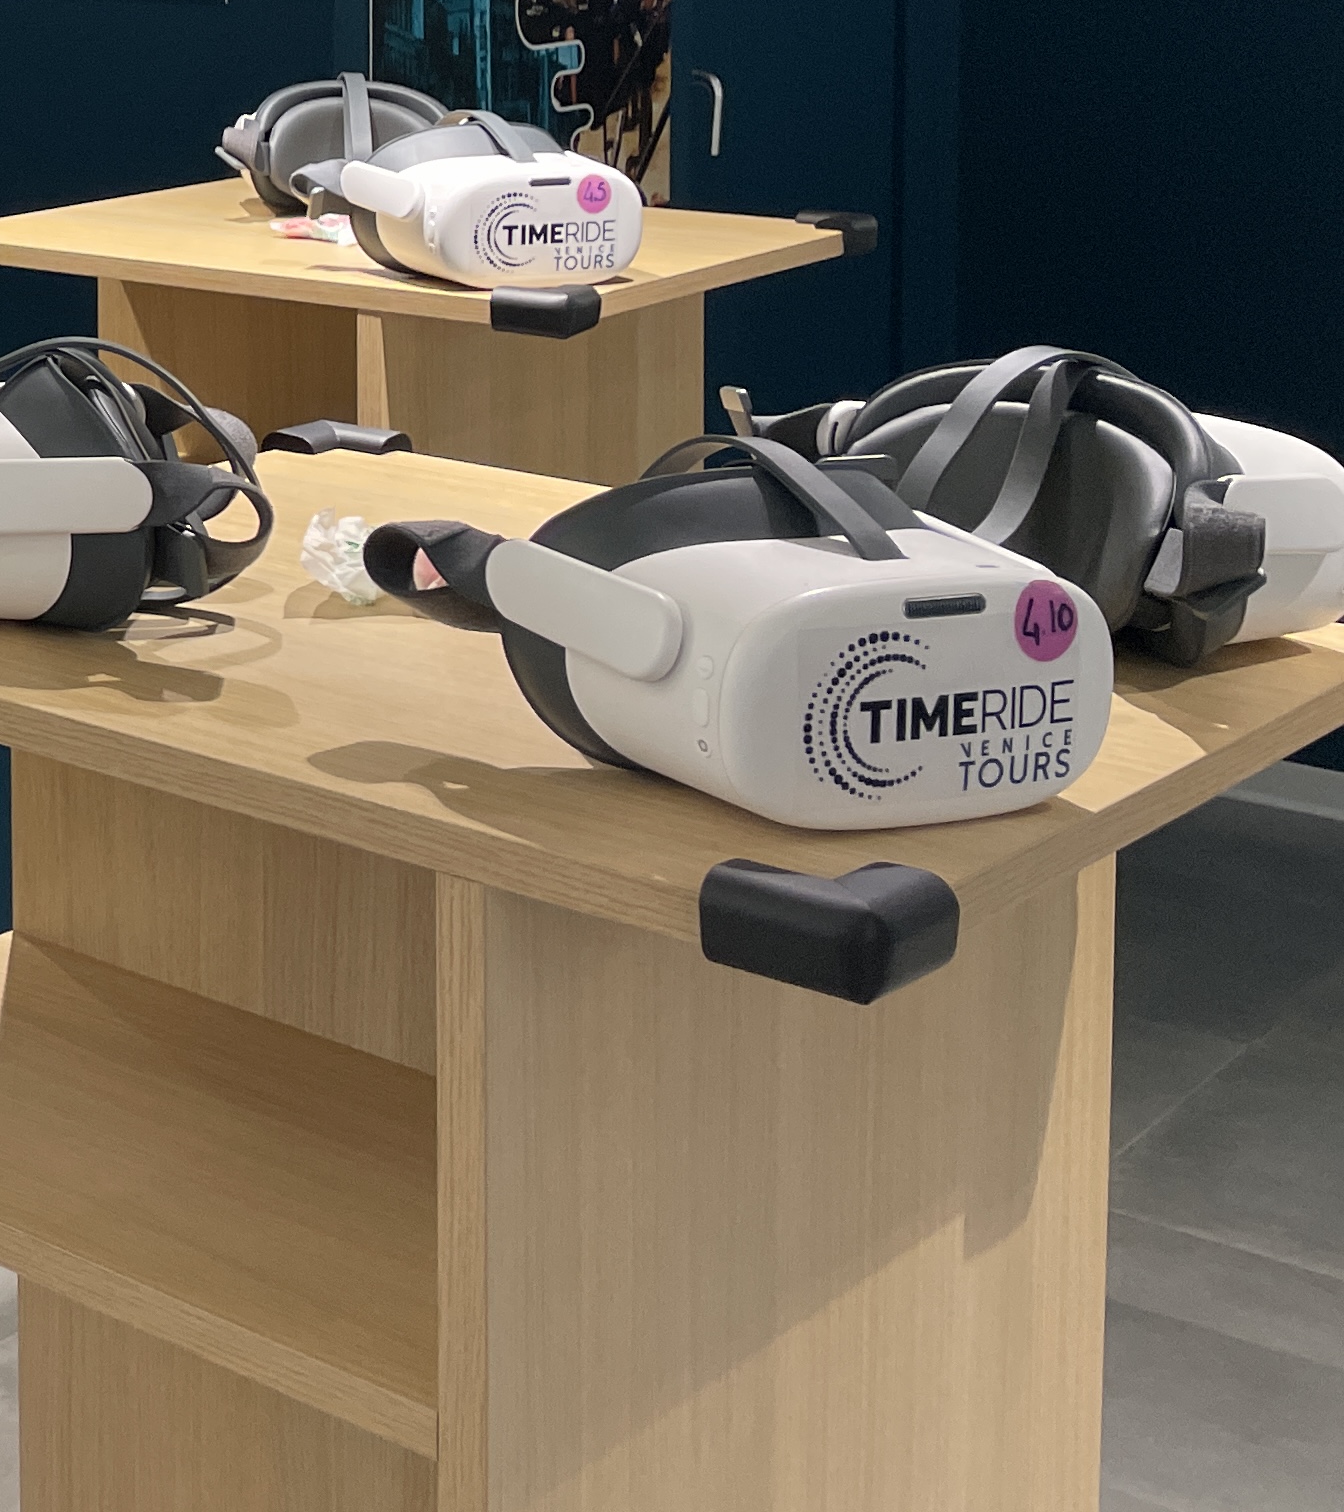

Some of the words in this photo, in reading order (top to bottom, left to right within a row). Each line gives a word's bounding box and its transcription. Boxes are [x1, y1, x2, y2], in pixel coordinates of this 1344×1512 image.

[554, 244, 616, 255] VENICE
[554, 253, 615, 271] TOURS
[960, 729, 1073, 758] VENICE
[958, 748, 1071, 791] TOURS
